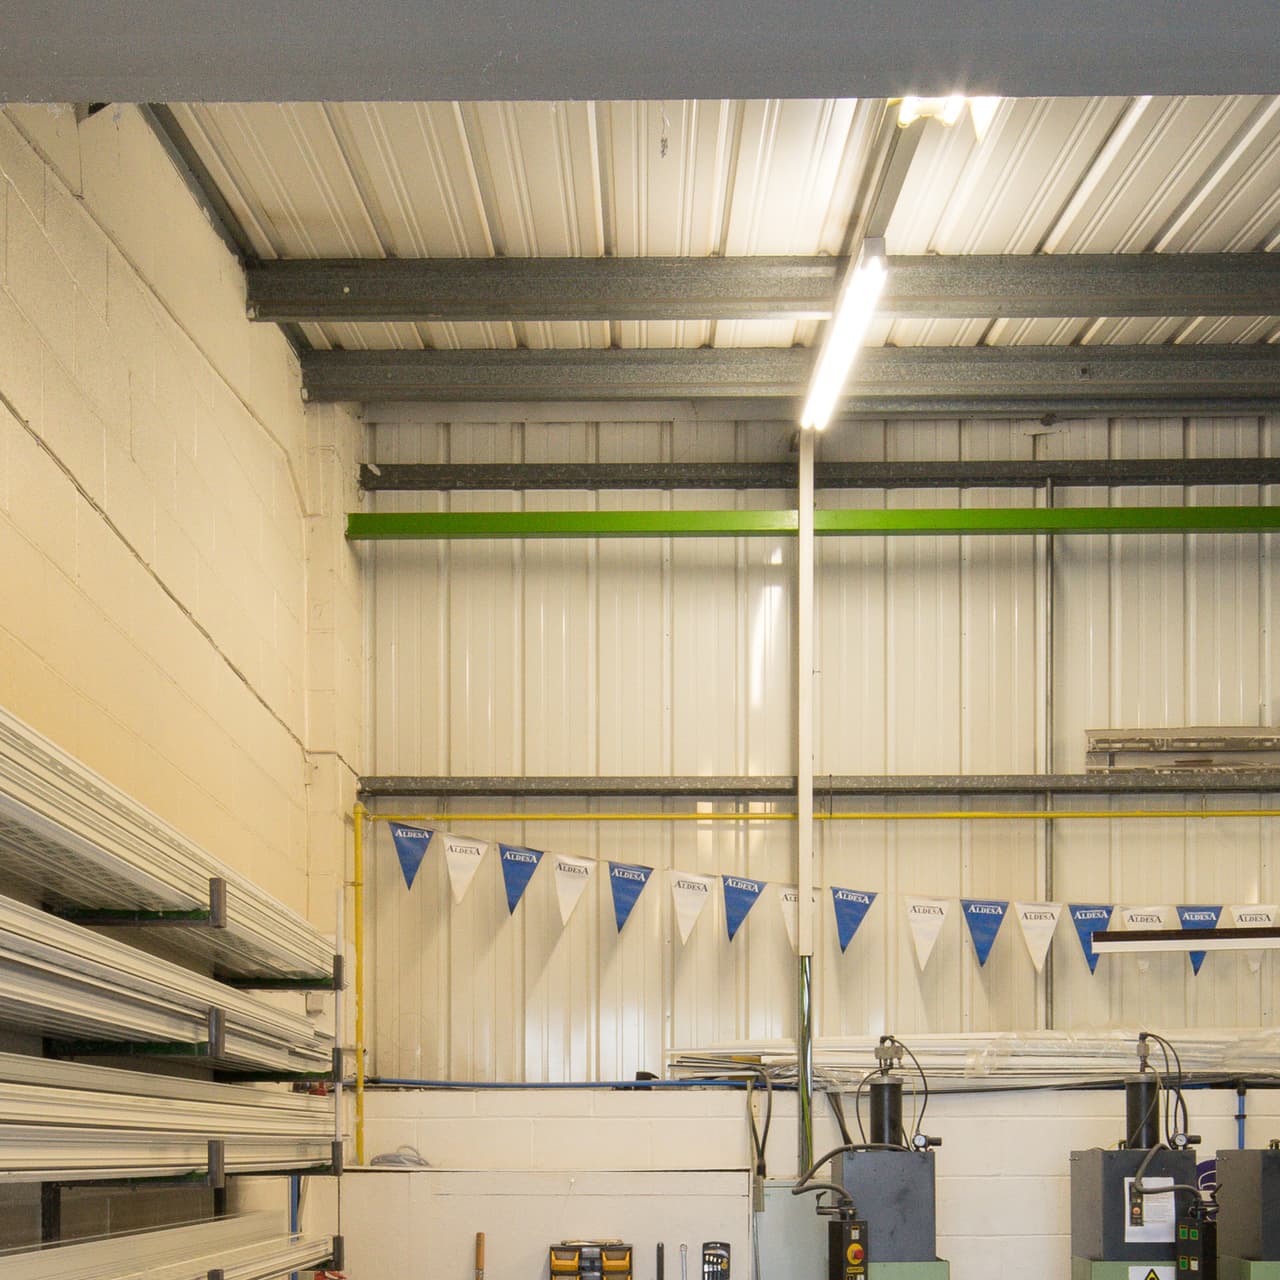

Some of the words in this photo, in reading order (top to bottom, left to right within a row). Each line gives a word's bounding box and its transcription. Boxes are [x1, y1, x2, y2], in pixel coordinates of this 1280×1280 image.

[395, 828, 429, 839] ALDESA
[447, 844, 480, 856] ALDESA
[503, 851, 537, 864] ALDESA
[555, 863, 589, 875] ALDESA
[611, 868, 645, 882] ALDESA
[674, 880, 708, 892] ALDESA
[725, 878, 759, 892] ALDESA
[835, 890, 870, 904] ALDESA
[910, 905, 944, 915] ALDESA
[968, 904, 1003, 915] ALDESA
[1074, 909, 1109, 919] ALDESA
[1022, 911, 1056, 920] ALDESA
[1128, 914, 1162, 924] ALDESA
[1182, 911, 1217, 921] ALDESA
[1237, 912, 1271, 922] ALDESA
